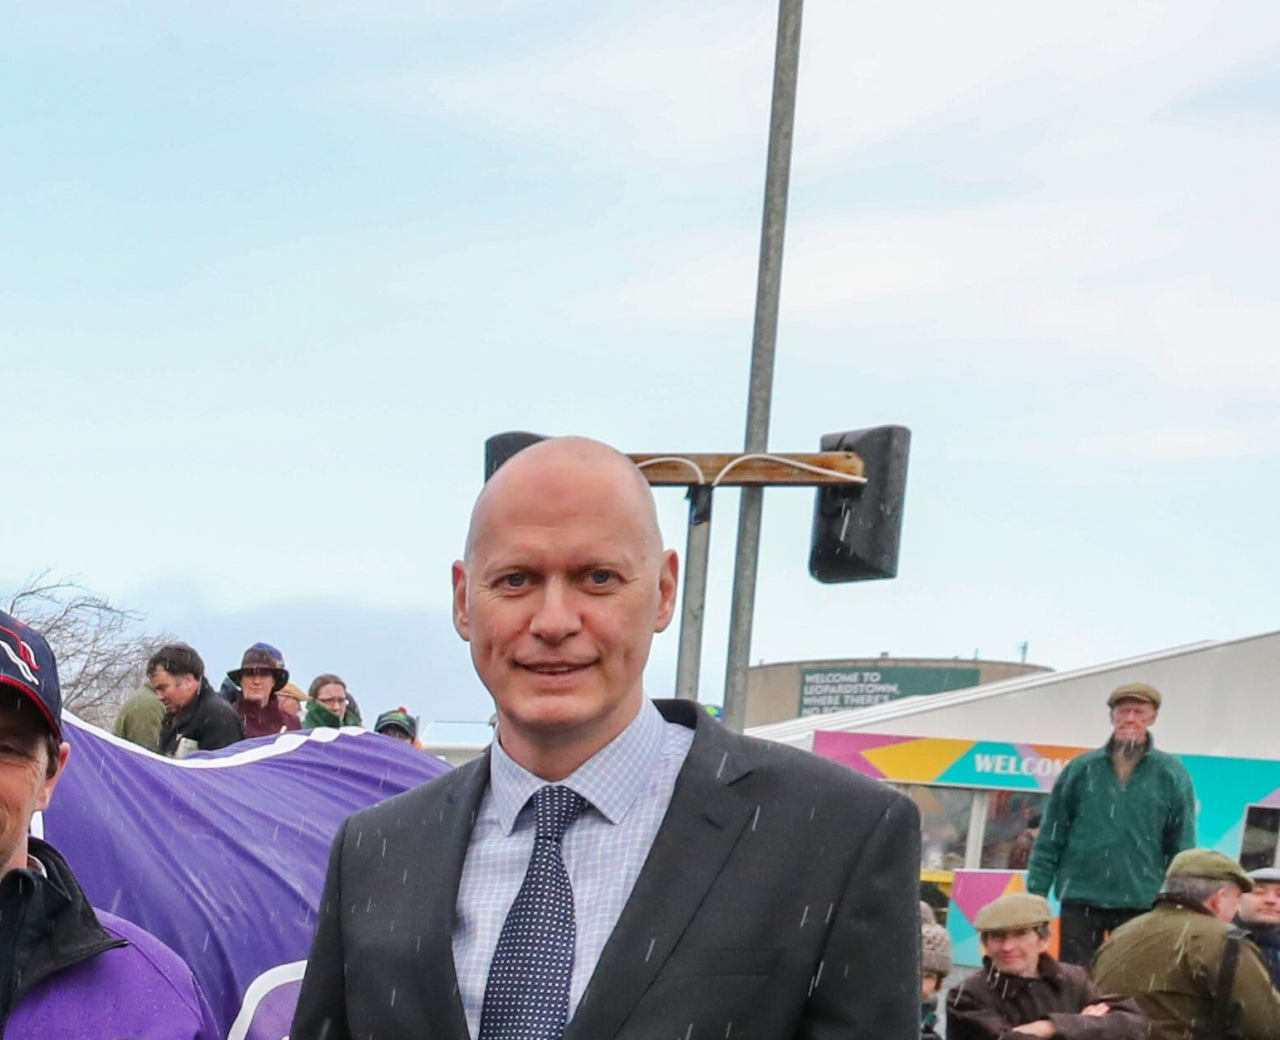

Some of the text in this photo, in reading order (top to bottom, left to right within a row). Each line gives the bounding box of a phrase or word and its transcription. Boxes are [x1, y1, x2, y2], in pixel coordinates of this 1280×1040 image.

[805, 672, 881, 683] WELCOME TO
[802, 695, 840, 705] WHERE
